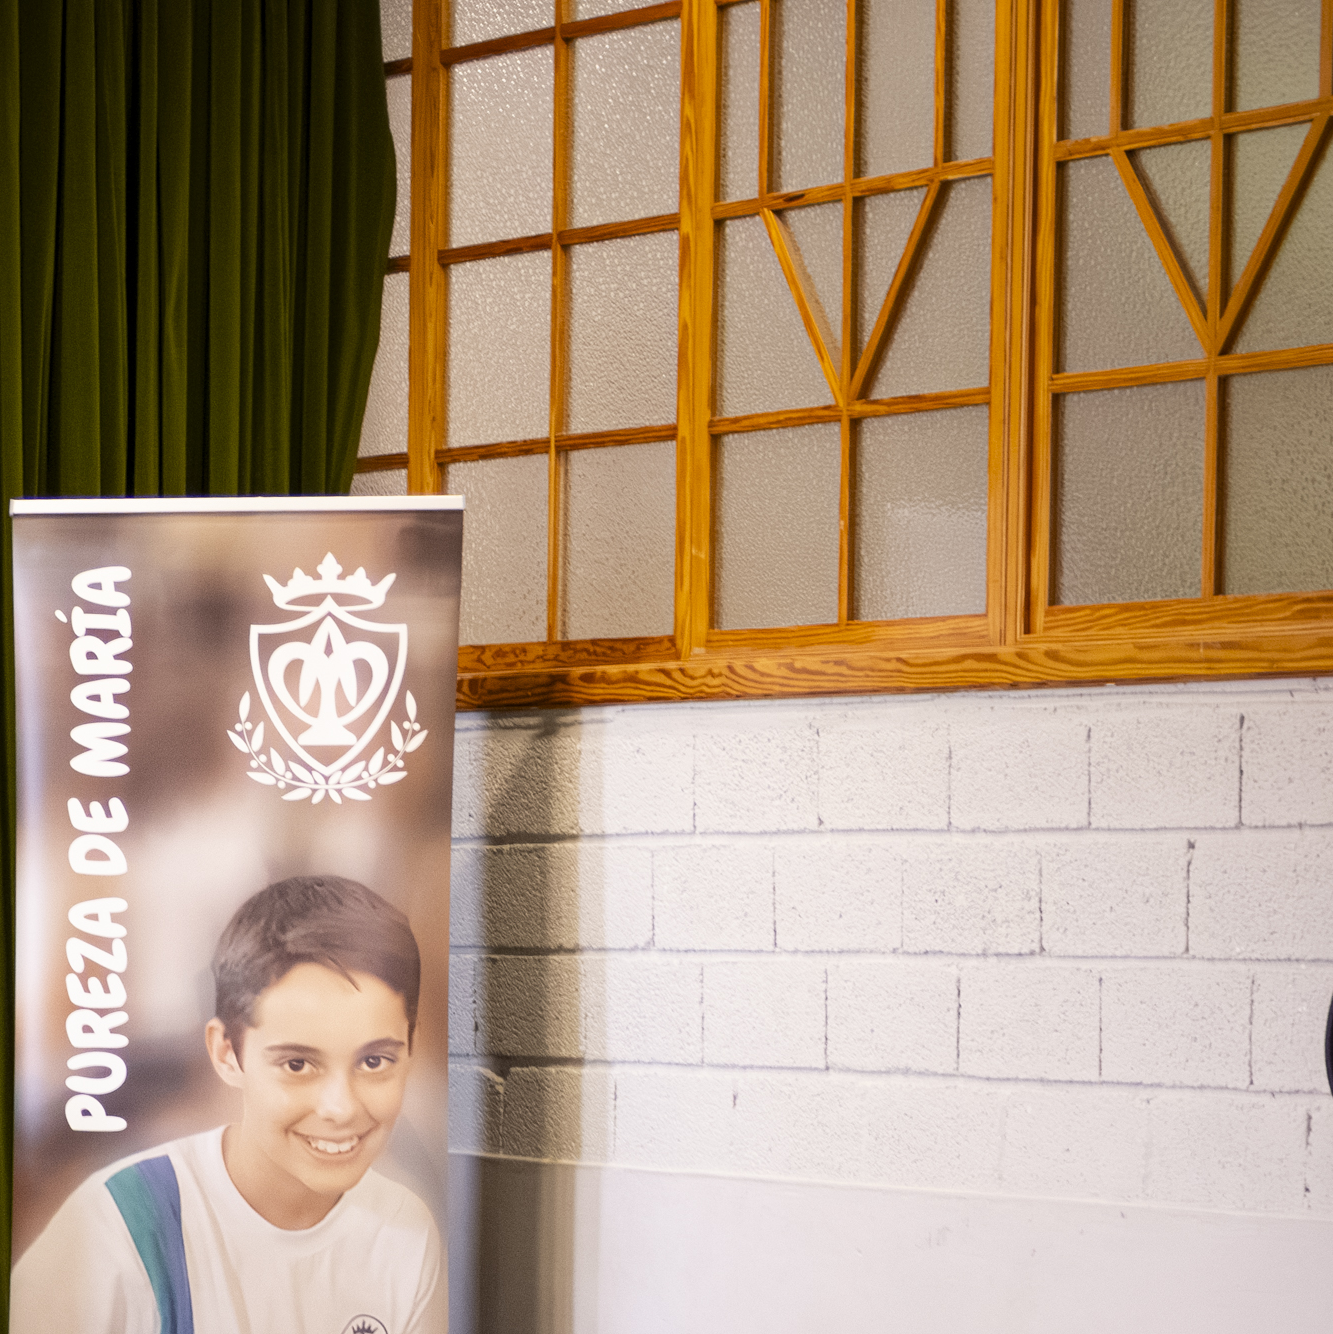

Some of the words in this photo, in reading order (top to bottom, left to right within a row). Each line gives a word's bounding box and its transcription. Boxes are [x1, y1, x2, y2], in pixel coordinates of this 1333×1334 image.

[54, 564, 134, 778] MARÍA
[67, 796, 130, 877] DE
[64, 896, 130, 1133] PUREZA
